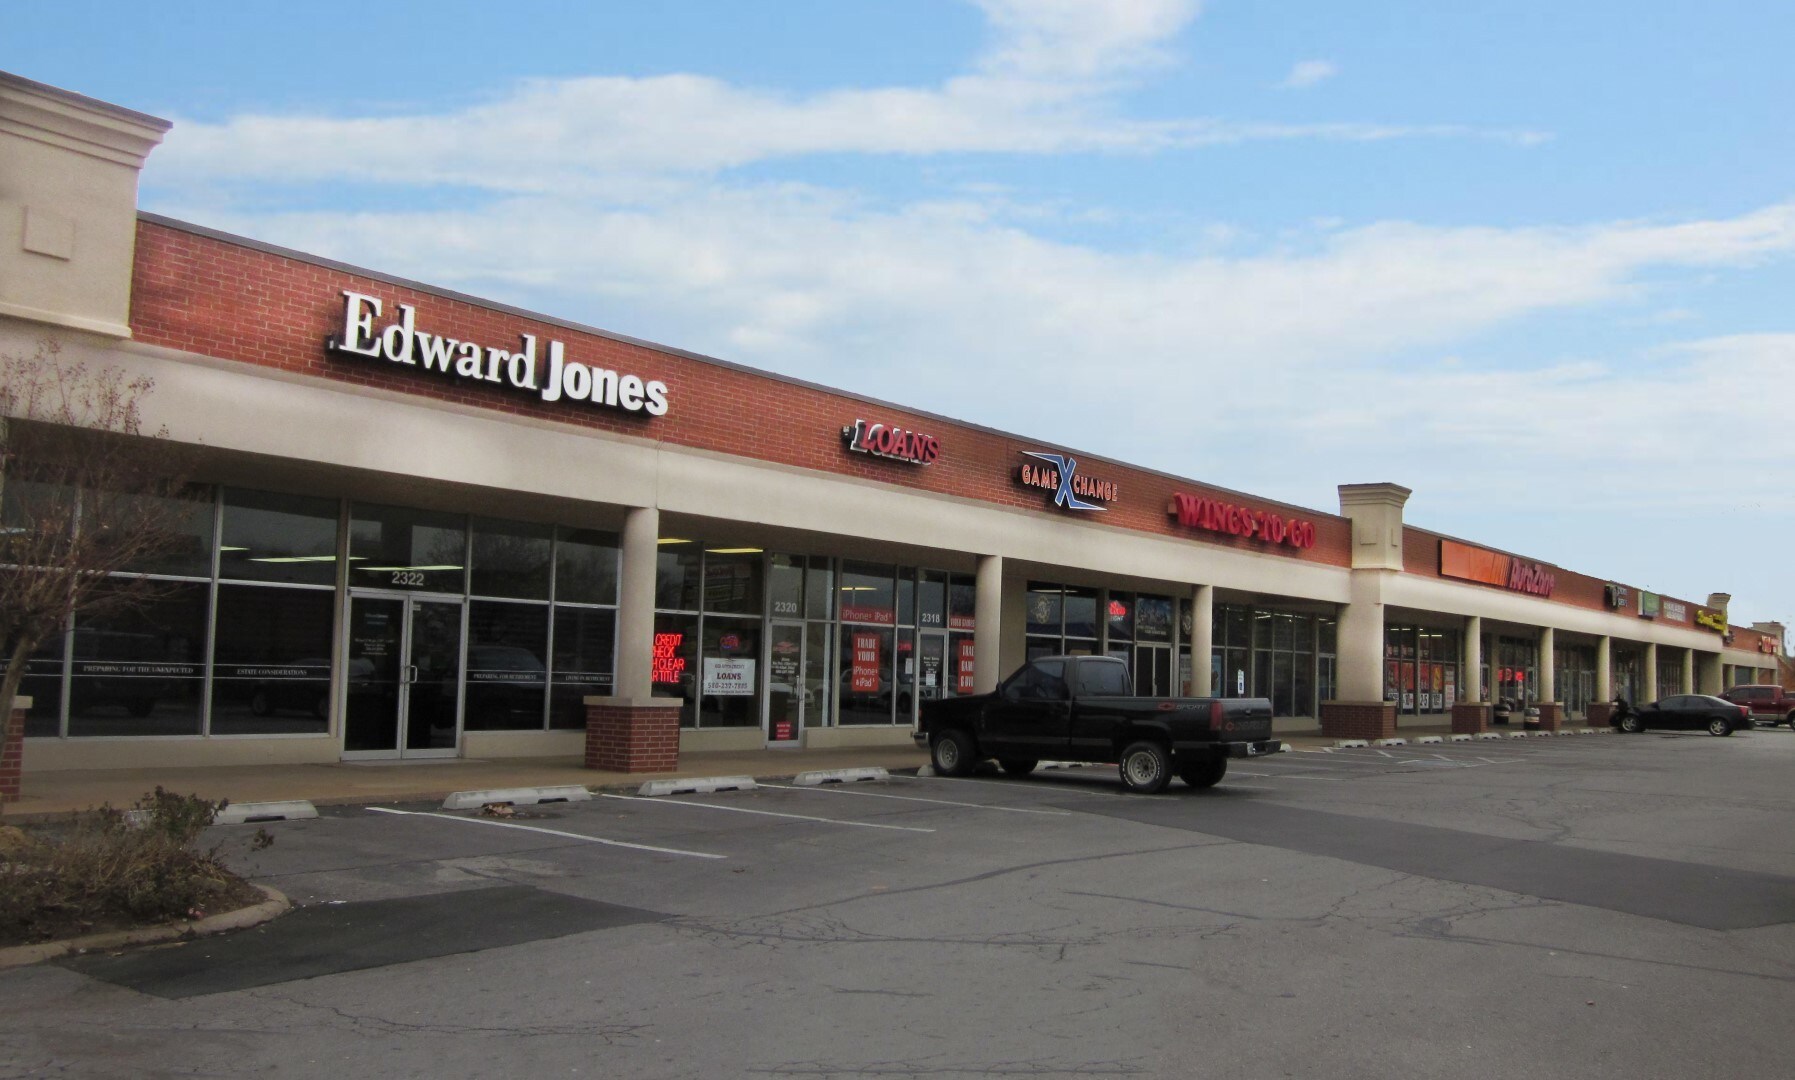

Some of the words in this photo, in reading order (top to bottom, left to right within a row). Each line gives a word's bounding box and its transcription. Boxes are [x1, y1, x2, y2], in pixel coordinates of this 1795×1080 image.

[338, 290, 537, 390] Edward
[542, 340, 669, 416] Jones
[850, 418, 942, 466] LOANS
[1021, 464, 1058, 490] GAME
[1073, 474, 1118, 502] CHANGE
[1173, 492, 1254, 537] WINGS
[1255, 510, 1285, 543] TO
[1286, 518, 1316, 549] GO
[391, 570, 425, 586] 2322
[1509, 557, 1555, 597] AutoZone
[774, 601, 798, 613] 2320
[921, 613, 940, 623] 2318
[655, 633, 683, 646] CREDIT
[857, 637, 876, 649] TRADE
[652, 646, 676, 658] HECK
[857, 651, 875, 662] YOUR
[83, 664, 121, 673] PREPARING
[122, 665, 136, 673] FOR
[659, 658, 685, 671] CLEAR
[258, 668, 307, 676] CONSIDERATIONS
[660, 671, 680, 683] TITLE
[716, 672, 742, 680] LOANS
